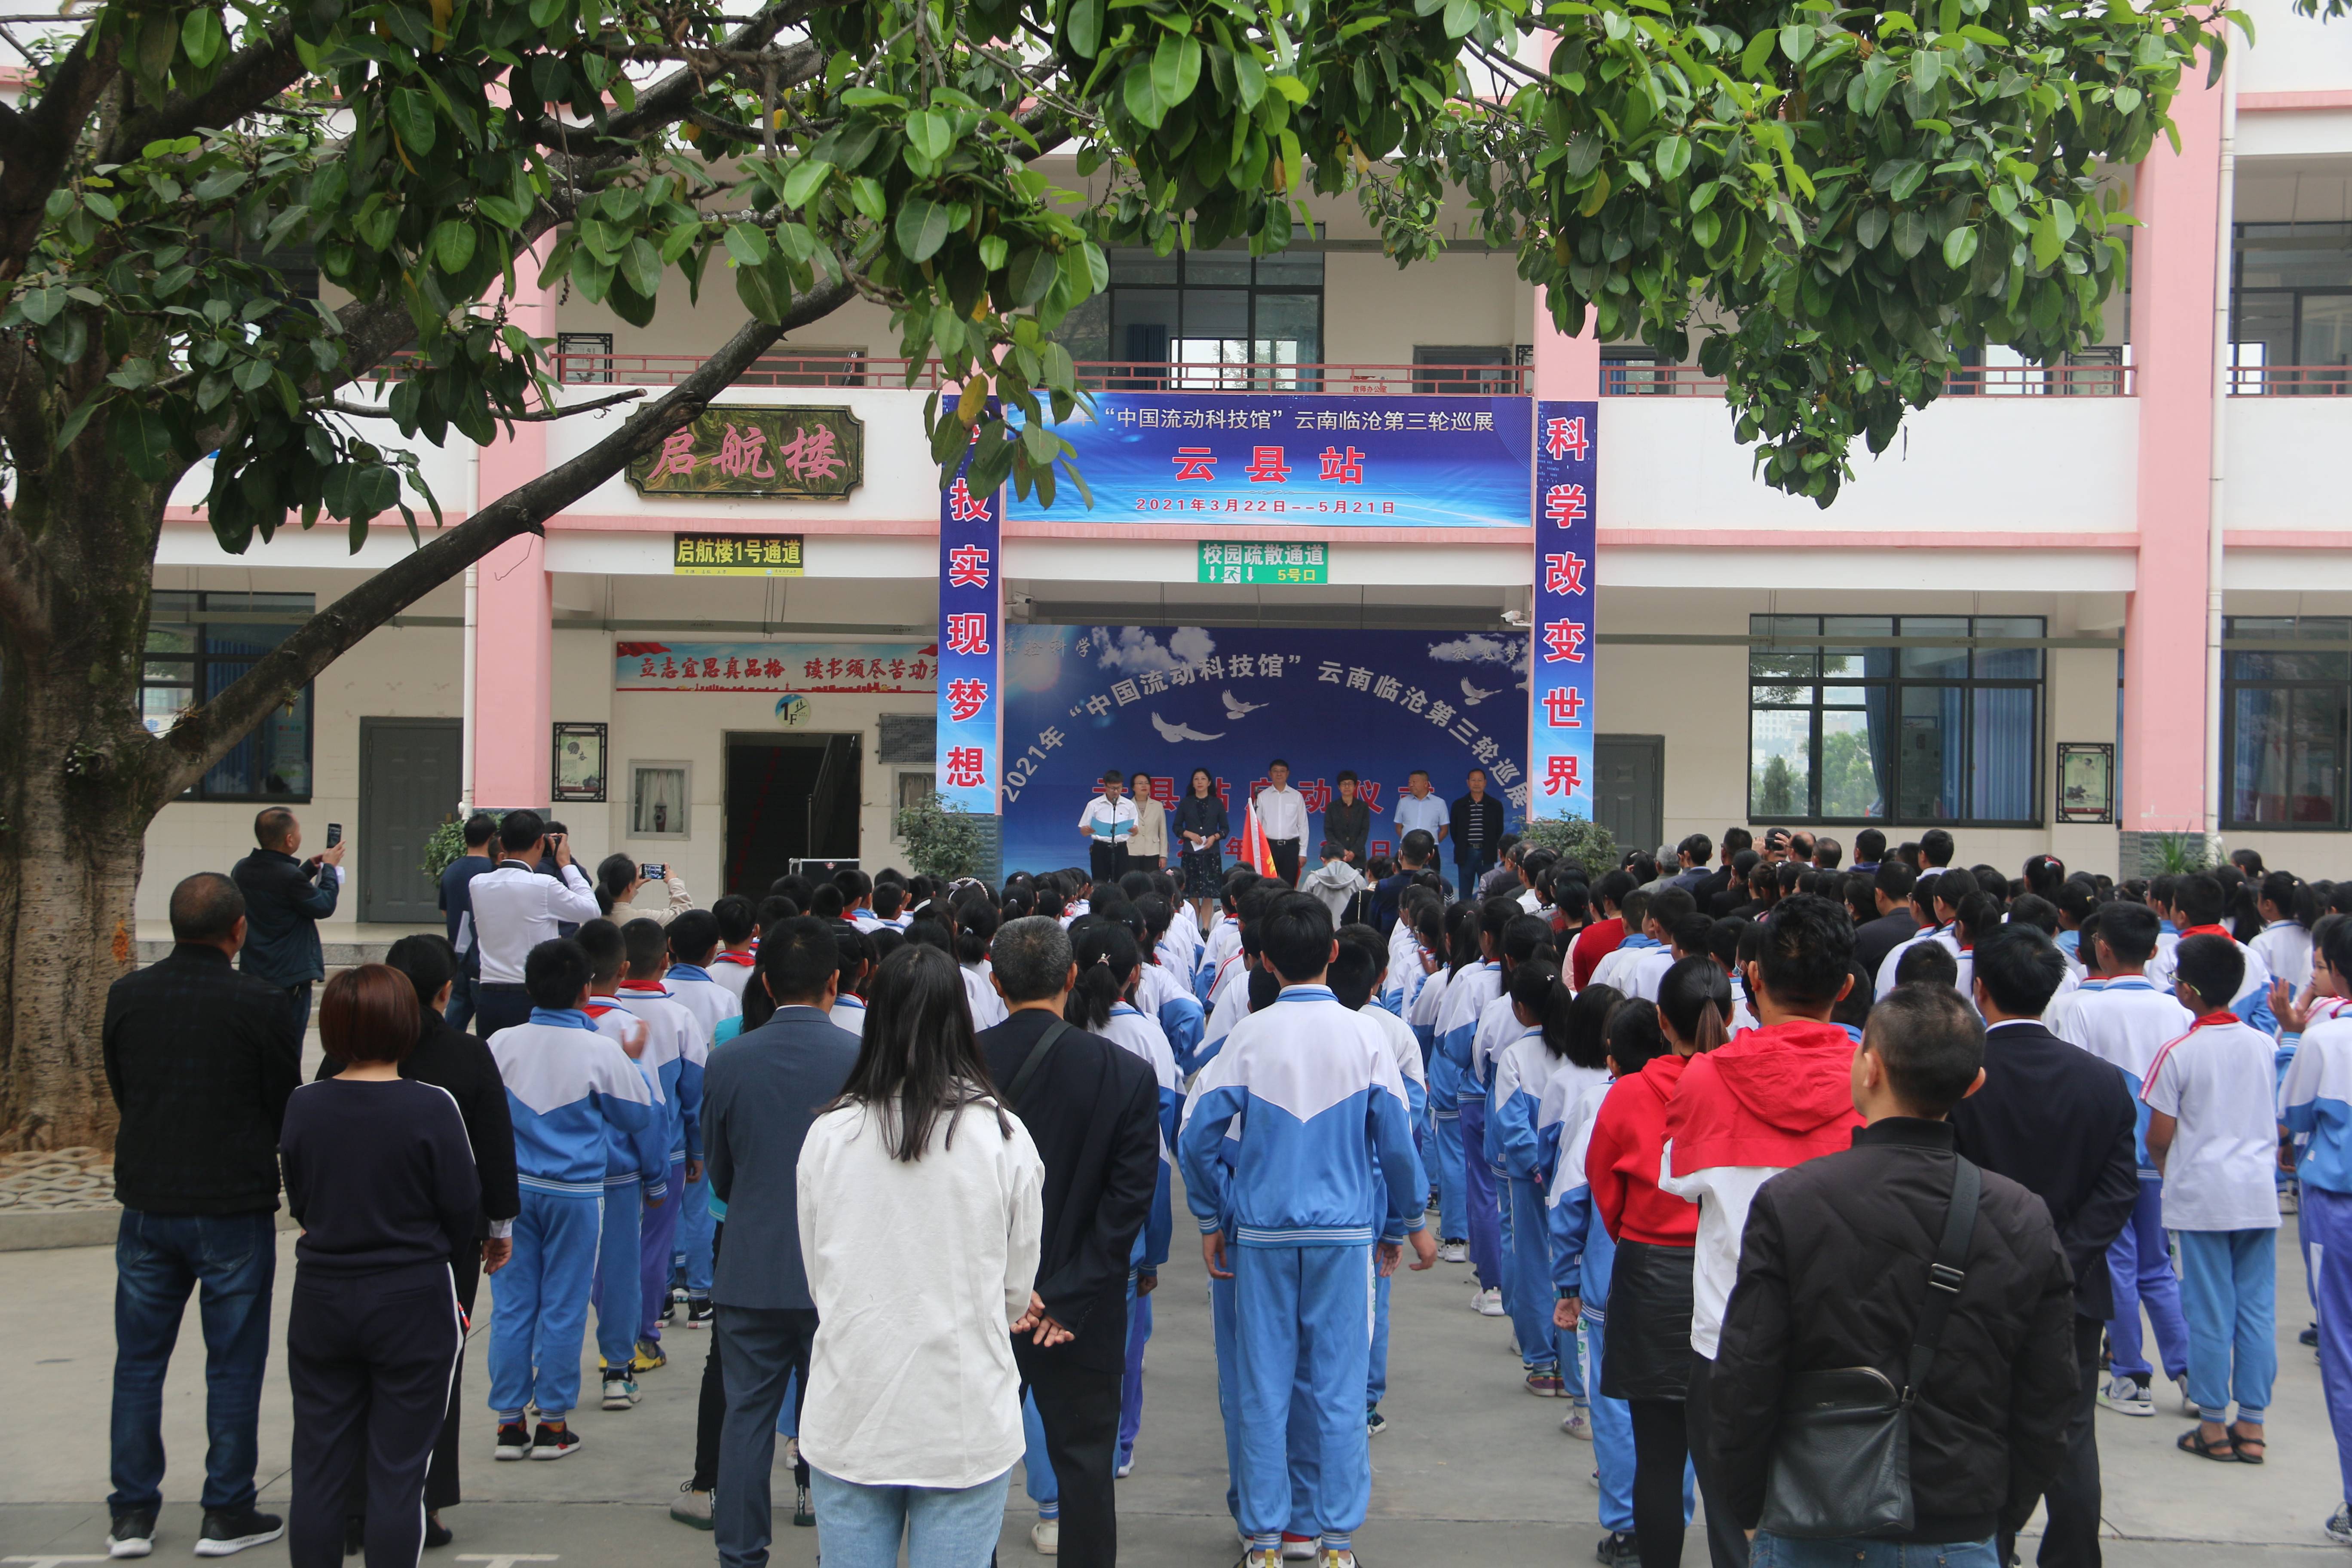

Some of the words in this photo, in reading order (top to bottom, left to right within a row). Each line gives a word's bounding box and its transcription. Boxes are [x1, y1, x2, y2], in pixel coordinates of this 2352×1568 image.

[649, 422, 846, 480] 启航楼
[1172, 445, 1366, 485] 云县站
[677, 538, 800, 564] 启航楼1号通道
[1203, 543, 1324, 565] 校园疏散通道
[1277, 568, 1315, 582] 5号口
[944, 409, 992, 789] 技实现梦想
[1542, 415, 1590, 797] 科学改变世界
[640, 656, 785, 680] 立志宜思真品格
